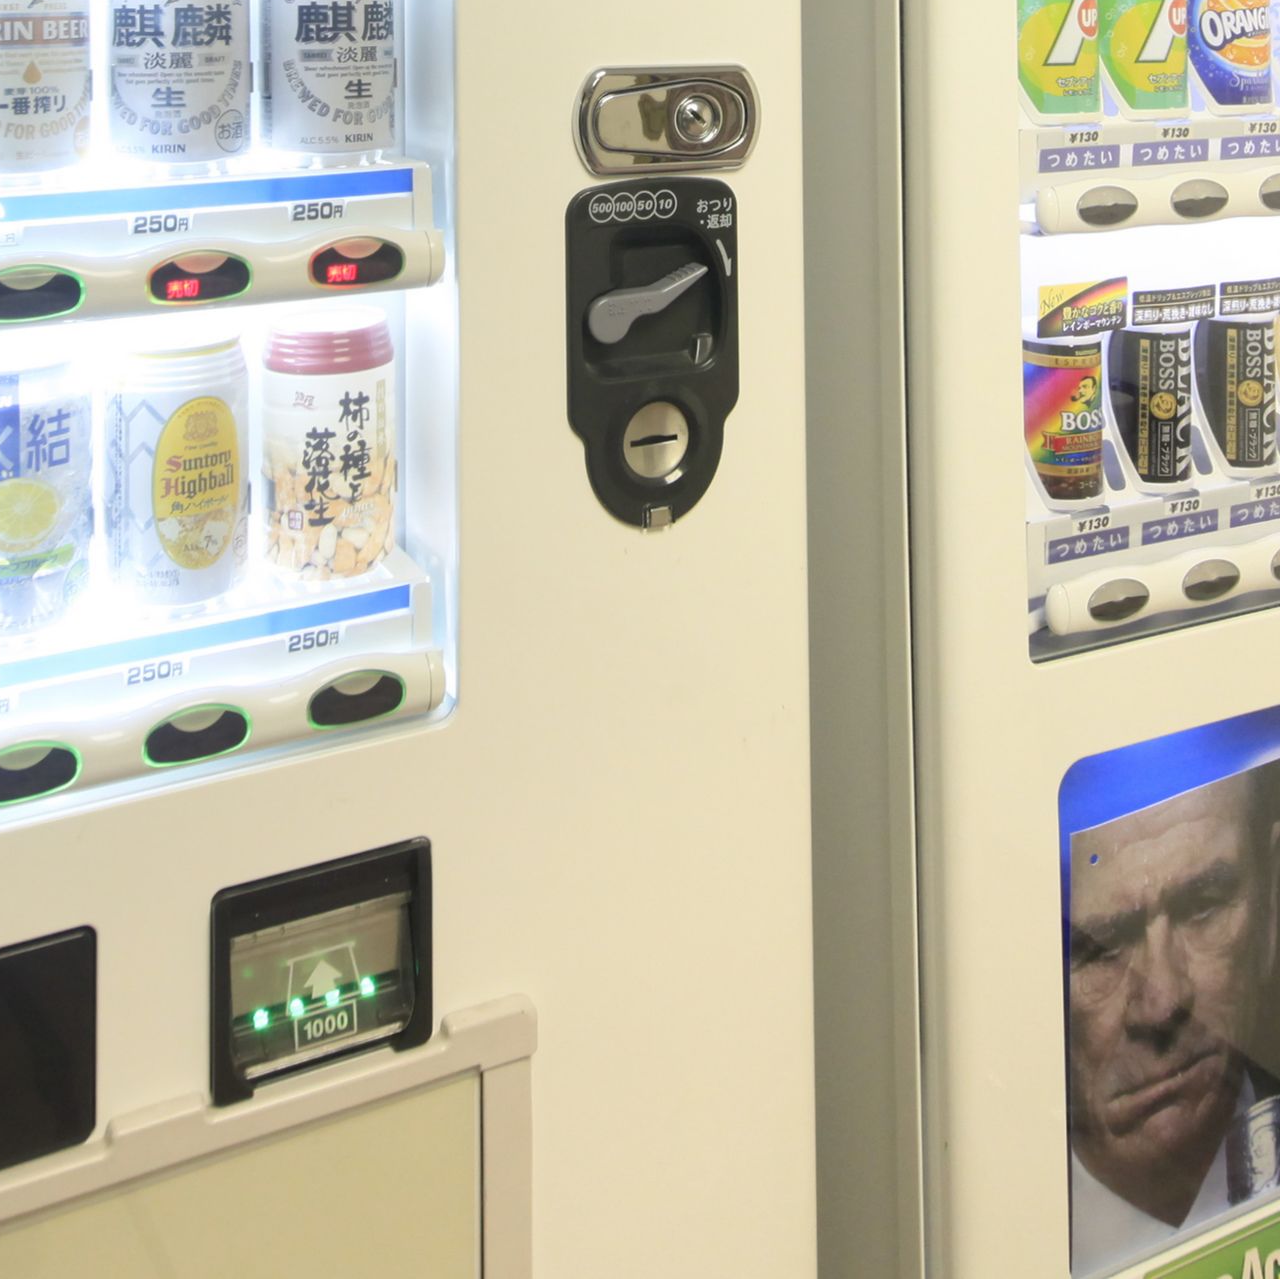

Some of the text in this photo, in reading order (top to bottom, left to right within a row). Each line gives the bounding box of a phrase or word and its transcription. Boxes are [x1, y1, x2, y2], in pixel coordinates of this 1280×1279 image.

[112, 4, 232, 48] 麒麟
[143, 52, 193, 69] 淡麗
[337, 47, 377, 63] 淡麗
[1069, 131, 1099, 144] ¥130
[1249, 122, 1277, 134] ¥130
[344, 133, 373, 144] KIRIN
[1047, 149, 1113, 167] つめたい
[292, 202, 343, 221] 250円
[592, 199, 672, 214] 500 100 50 10
[696, 198, 732, 213] おつり
[134, 215, 189, 234] 250円
[327, 264, 357, 282] 売切
[166, 279, 199, 299] 売切
[1246, 329, 1262, 378] BOSS
[1159, 339, 1175, 390] BOSS
[165, 449, 231, 473] Suntory
[160, 465, 234, 500] Highball
[303, 427, 340, 527] 落花生
[1170, 499, 1200, 514] ¥130
[1056, 532, 1122, 557] つめたい
[288, 629, 340, 653] 250円
[303, 1010, 348, 1040] 1000
